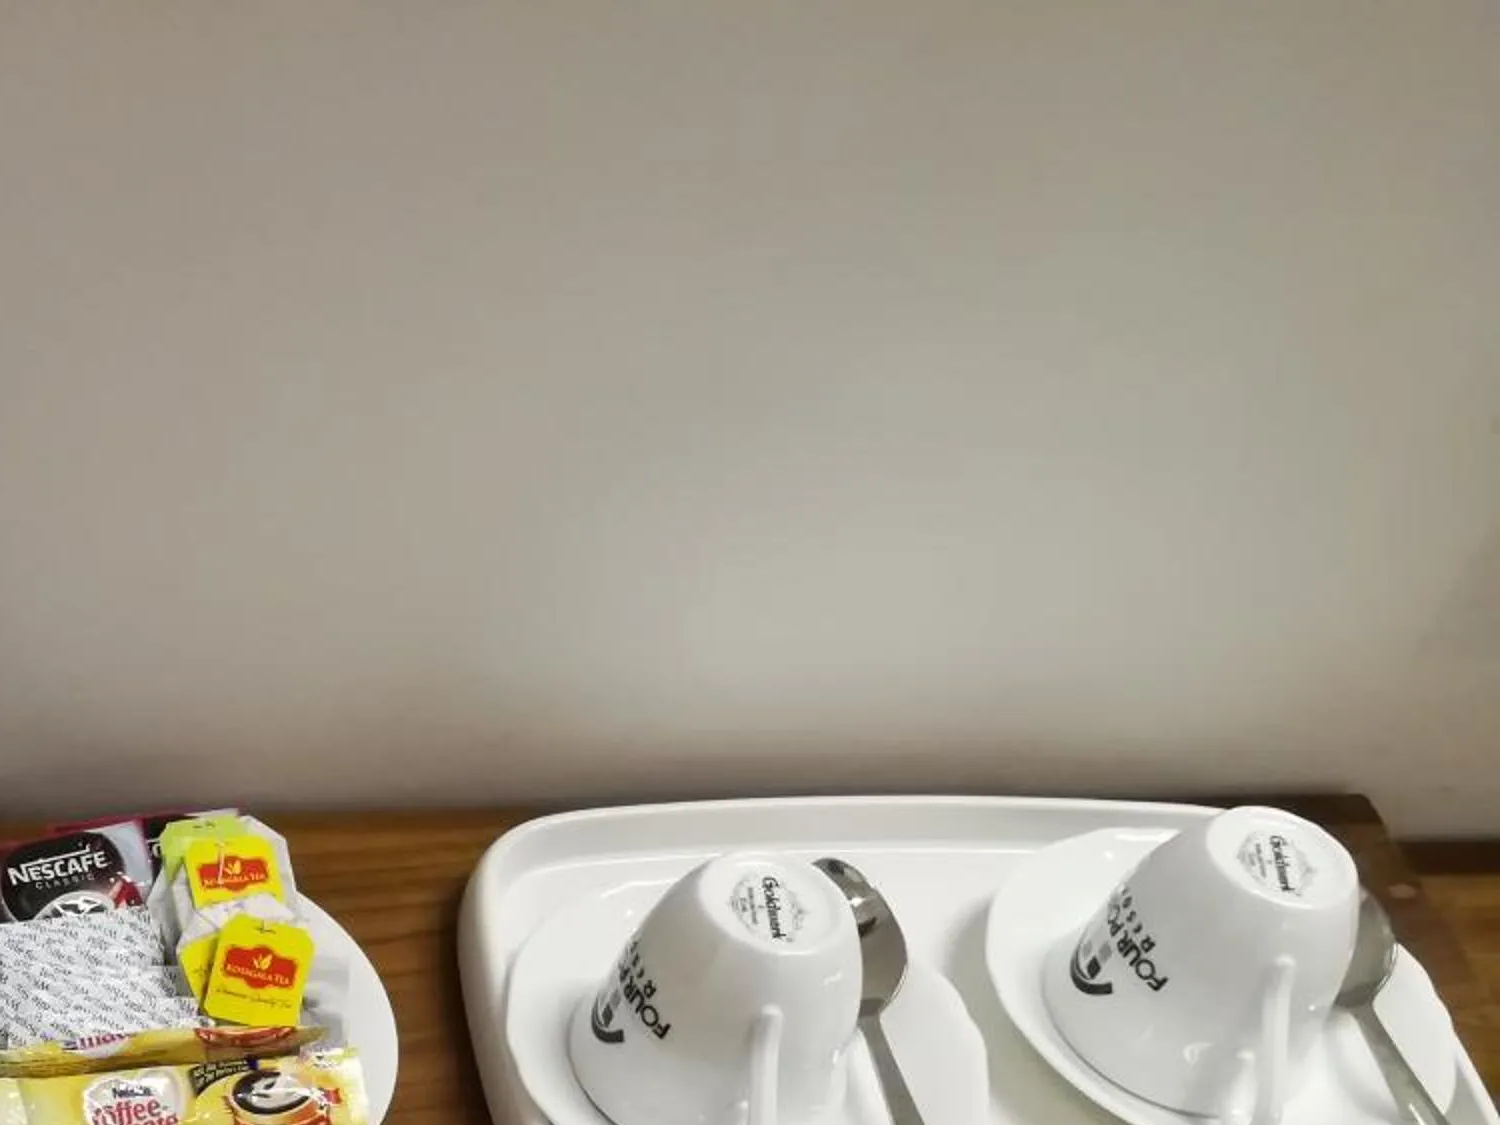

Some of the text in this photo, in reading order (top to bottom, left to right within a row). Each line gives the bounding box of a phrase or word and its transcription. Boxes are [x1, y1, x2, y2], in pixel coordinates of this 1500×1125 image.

[35, 873, 95, 891] CLASSIC
[274, 972, 291, 985] TEA
[1117, 930, 1169, 992] FOUR
[624, 975, 671, 1040] FOUR
